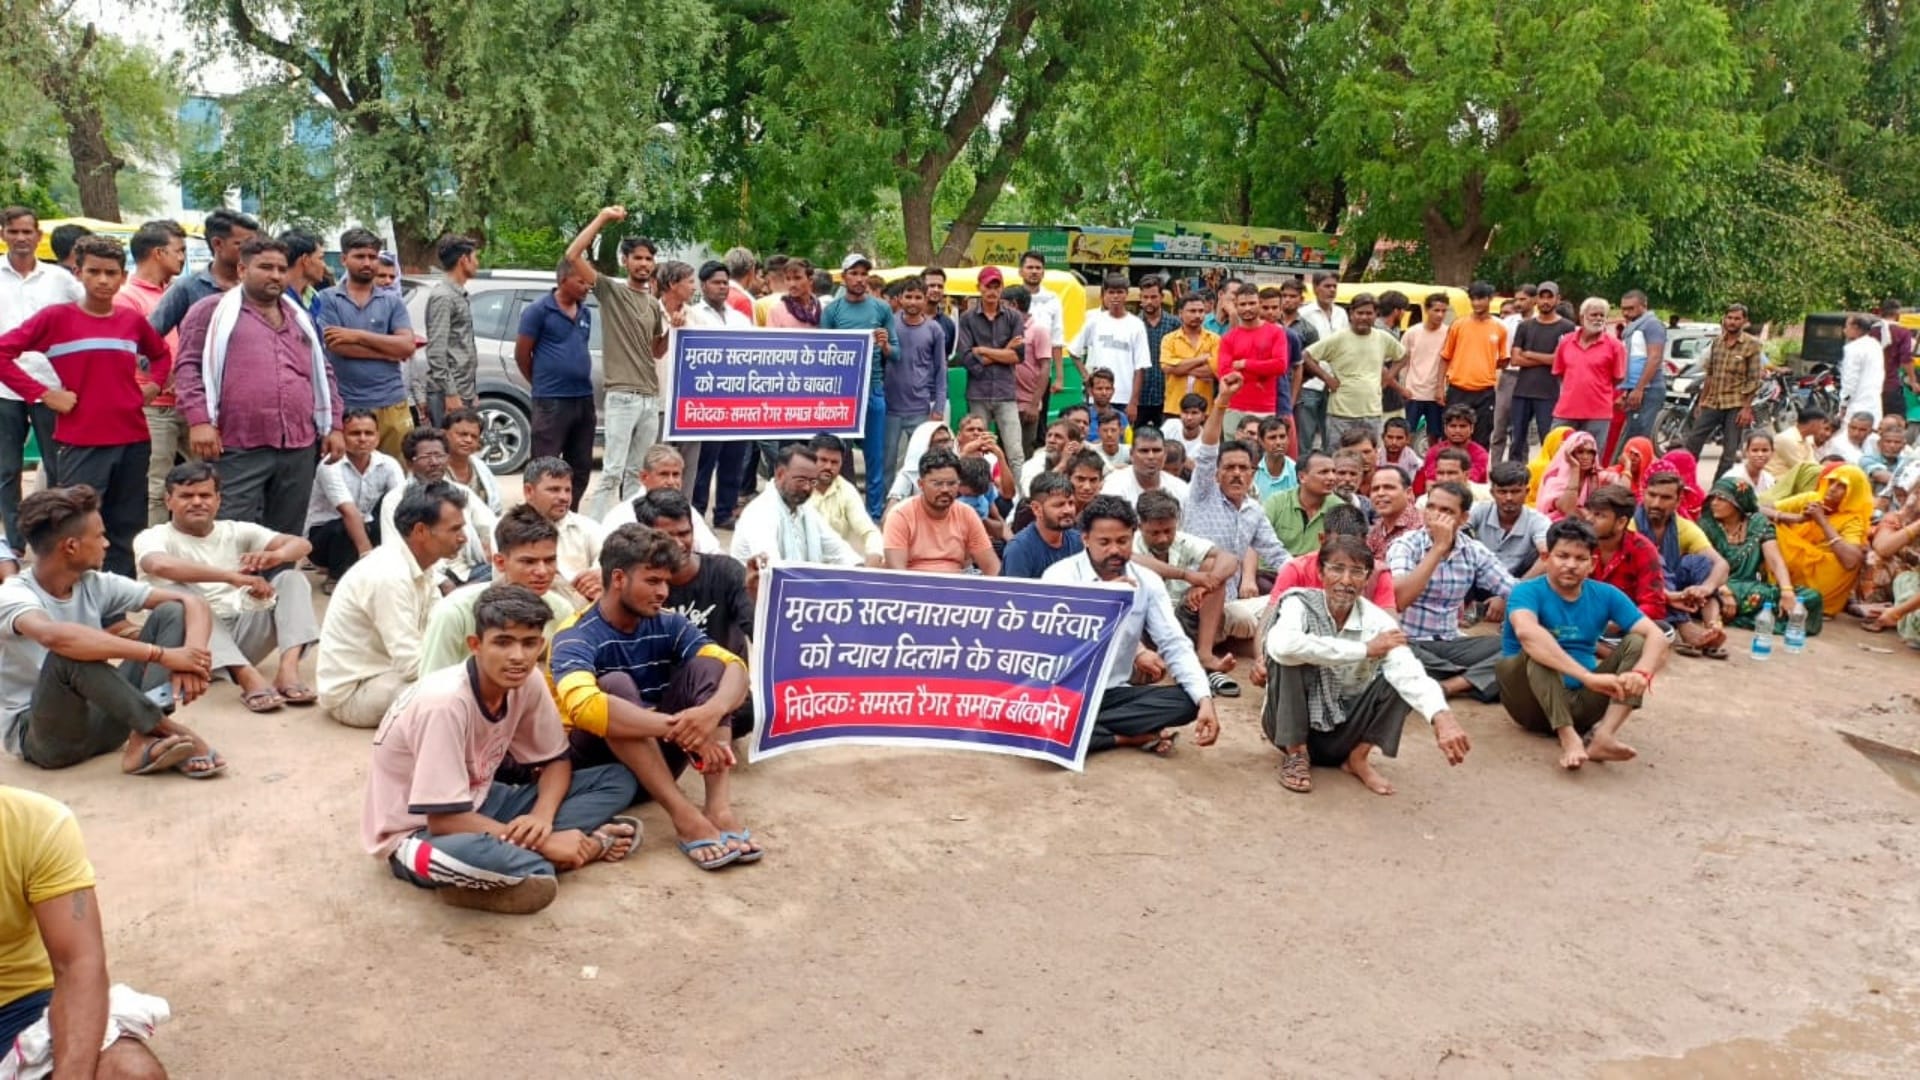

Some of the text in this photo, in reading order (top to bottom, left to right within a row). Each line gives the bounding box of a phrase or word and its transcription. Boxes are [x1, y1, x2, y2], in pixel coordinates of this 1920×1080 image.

[685, 344, 857, 369] मृतक सत्यनारायण के परिवार
[695, 371, 714, 393] को
[716, 375, 745, 393] न्याय
[748, 370, 784, 393] दिलाने
[787, 372, 801, 393] के
[731, 406, 761, 423] समस्त
[763, 402, 781, 422] रैगर
[784, 406, 812, 422] समाज
[813, 401, 849, 421] बीकानेर
[785, 597, 1106, 641] मृतक सत्यनारायण के परिवार
[800, 633, 834, 669] को
[838, 643, 890, 668] न्याय
[893, 633, 962, 671] दिलाने
[966, 639, 994, 671] के
[859, 691, 912, 716] समस्त
[916, 687, 951, 716] रैगर
[956, 694, 1006, 721] समाज
[1005, 692, 1071, 732] बीकानेर
